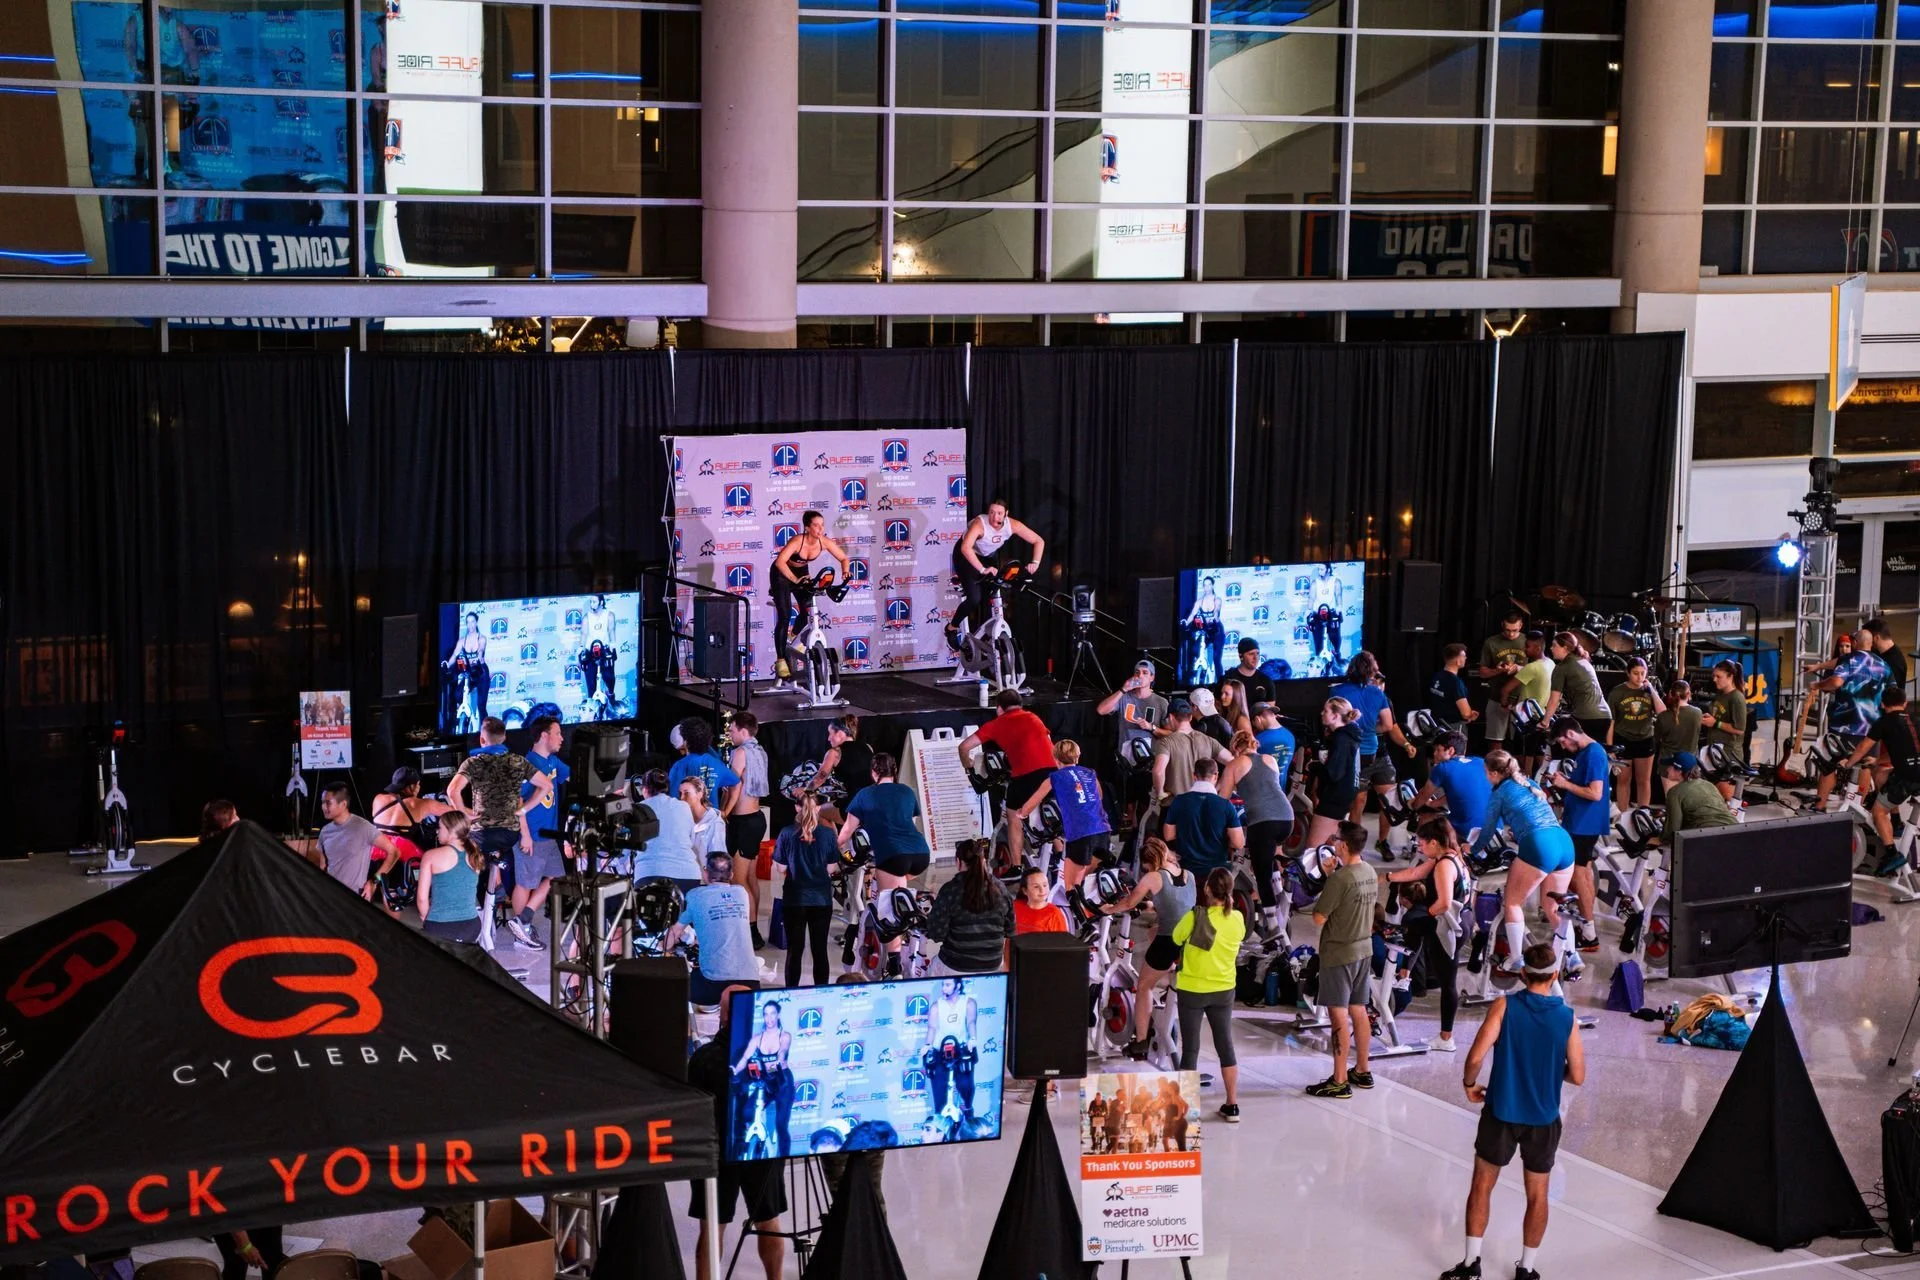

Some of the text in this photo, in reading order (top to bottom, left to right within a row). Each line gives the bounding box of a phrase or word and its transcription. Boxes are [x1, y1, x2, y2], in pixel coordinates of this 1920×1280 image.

[1902, 383, 1912, 395] of
[172, 1043, 452, 1086] CYCLEBAR
[1086, 1159, 1196, 1172] Thank You Sponsors
[4, 1119, 674, 1243] ROCK YOUR RIDE
[1125, 1184, 1179, 1195] RUFF RIDE
[1113, 1207, 1149, 1218] aetna
[1104, 1217, 1187, 1228] medicare solutions
[1153, 1233, 1199, 1248] UPMC
[1105, 1244, 1144, 1254] Pittsburgh
